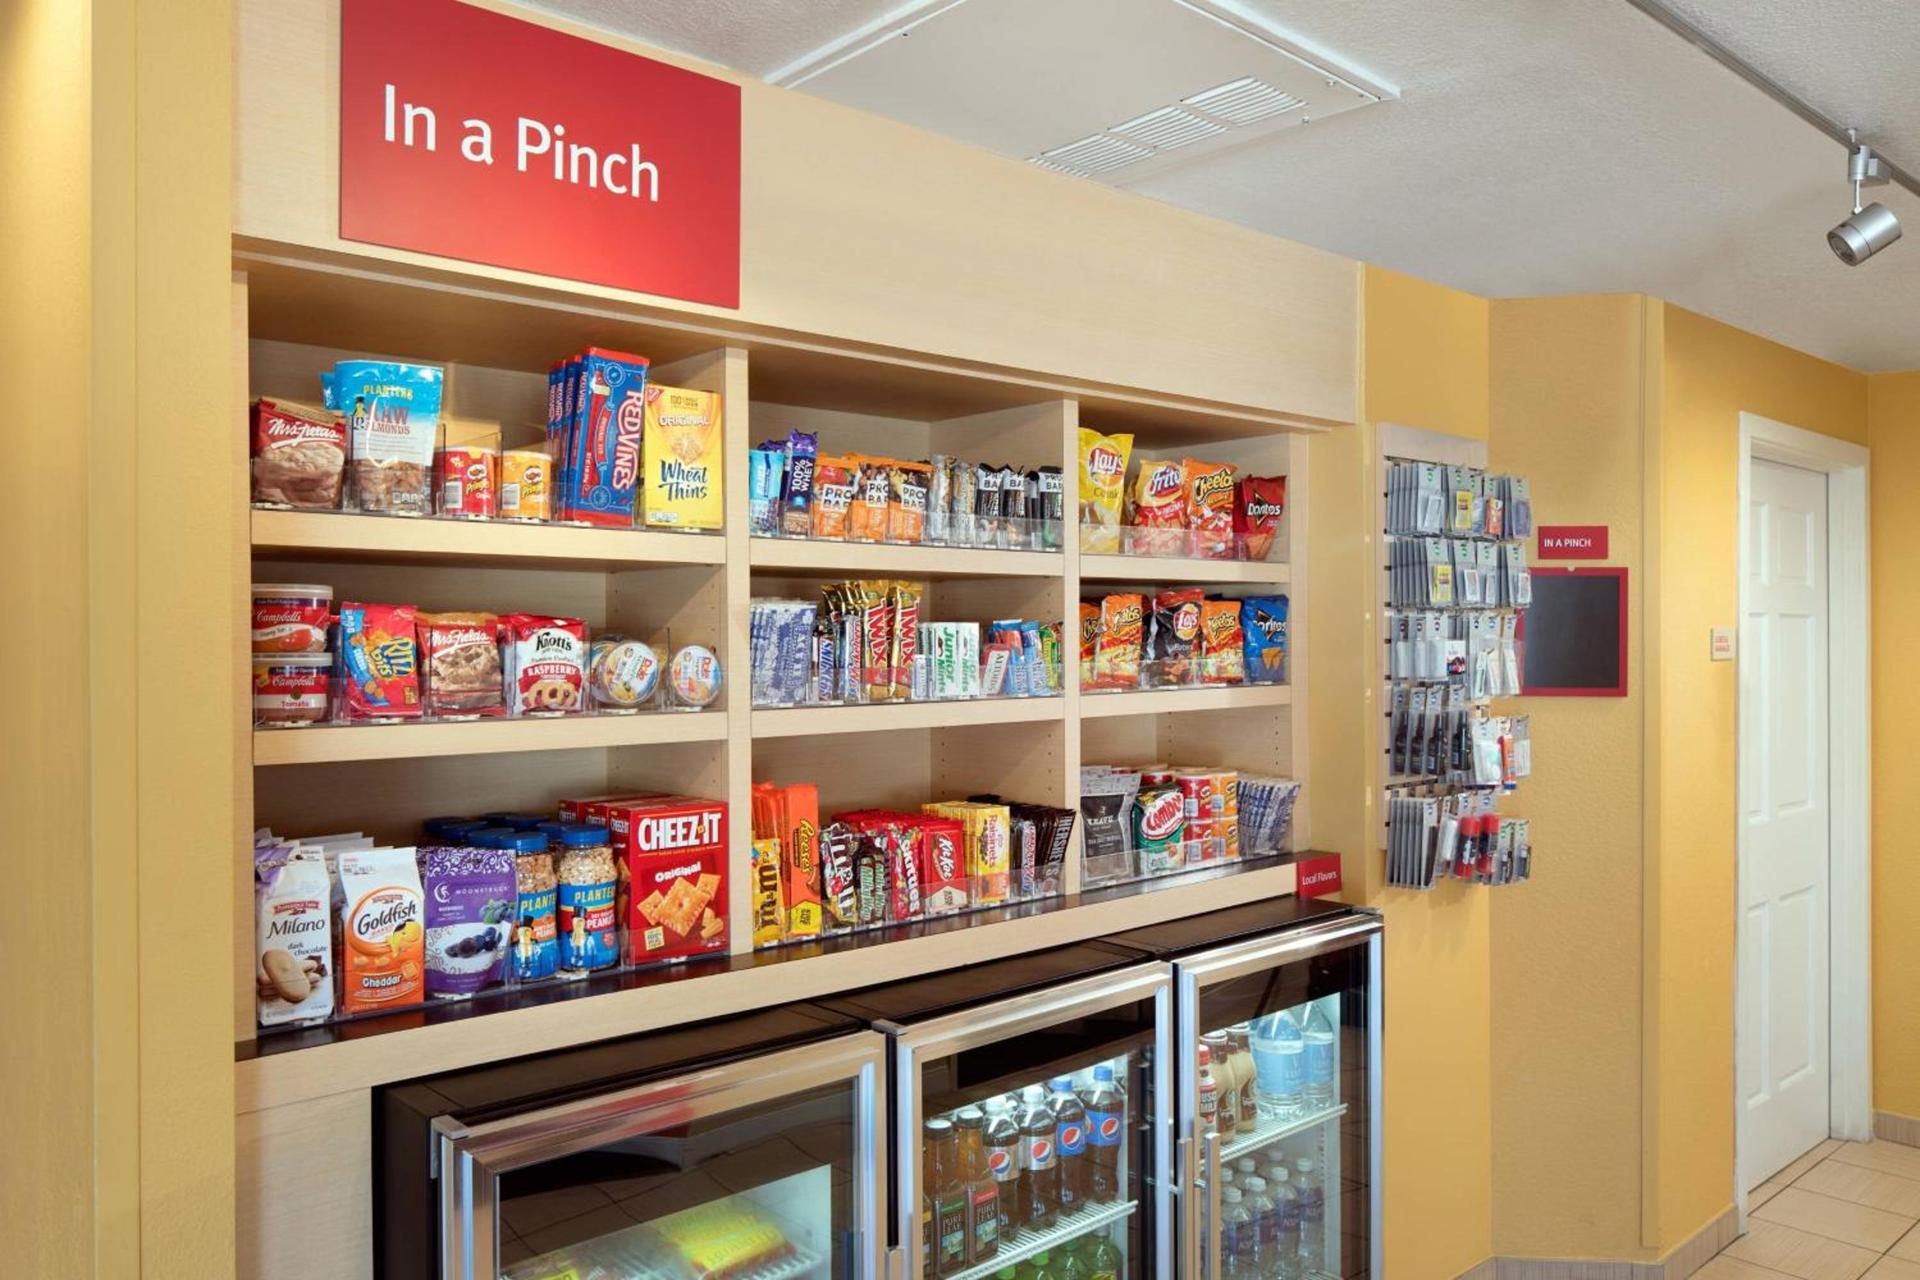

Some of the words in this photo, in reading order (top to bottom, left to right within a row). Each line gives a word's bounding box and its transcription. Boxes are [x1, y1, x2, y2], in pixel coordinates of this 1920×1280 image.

[384, 84, 436, 152] In
[461, 118, 494, 166] a
[517, 116, 659, 202] Pinch
[659, 414, 711, 427] ORIGINAL
[661, 458, 708, 483] Wheat
[1091, 448, 1124, 474] Lay's
[792, 458, 807, 492] 100%
[800, 459, 814, 492] WHEY
[984, 479, 999, 489] BA
[1193, 468, 1233, 501] Cheeto
[658, 481, 708, 502] Thins
[825, 487, 852, 500] PRO
[903, 487, 926, 500] PRO
[1247, 502, 1281, 516] Doritos
[1544, 537, 1554, 548] IN
[1555, 537, 1563, 548] A
[1564, 537, 1592, 548] PINCH
[535, 631, 572, 651] Knott's
[866, 597, 888, 667] TWIX
[900, 597, 920, 666] TWIX
[383, 637, 413, 676] RITZ
[943, 627, 956, 683] Junior
[527, 664, 577, 677] RASPBERRY
[1302, 873, 1318, 886] Local
[1317, 871, 1337, 882] Flavors
[265, 917, 325, 939] Milano
[357, 899, 417, 936] Goldfish
[287, 942, 304, 951] dark
[294, 945, 328, 957] chocolate
[362, 975, 402, 989] Cheddar
